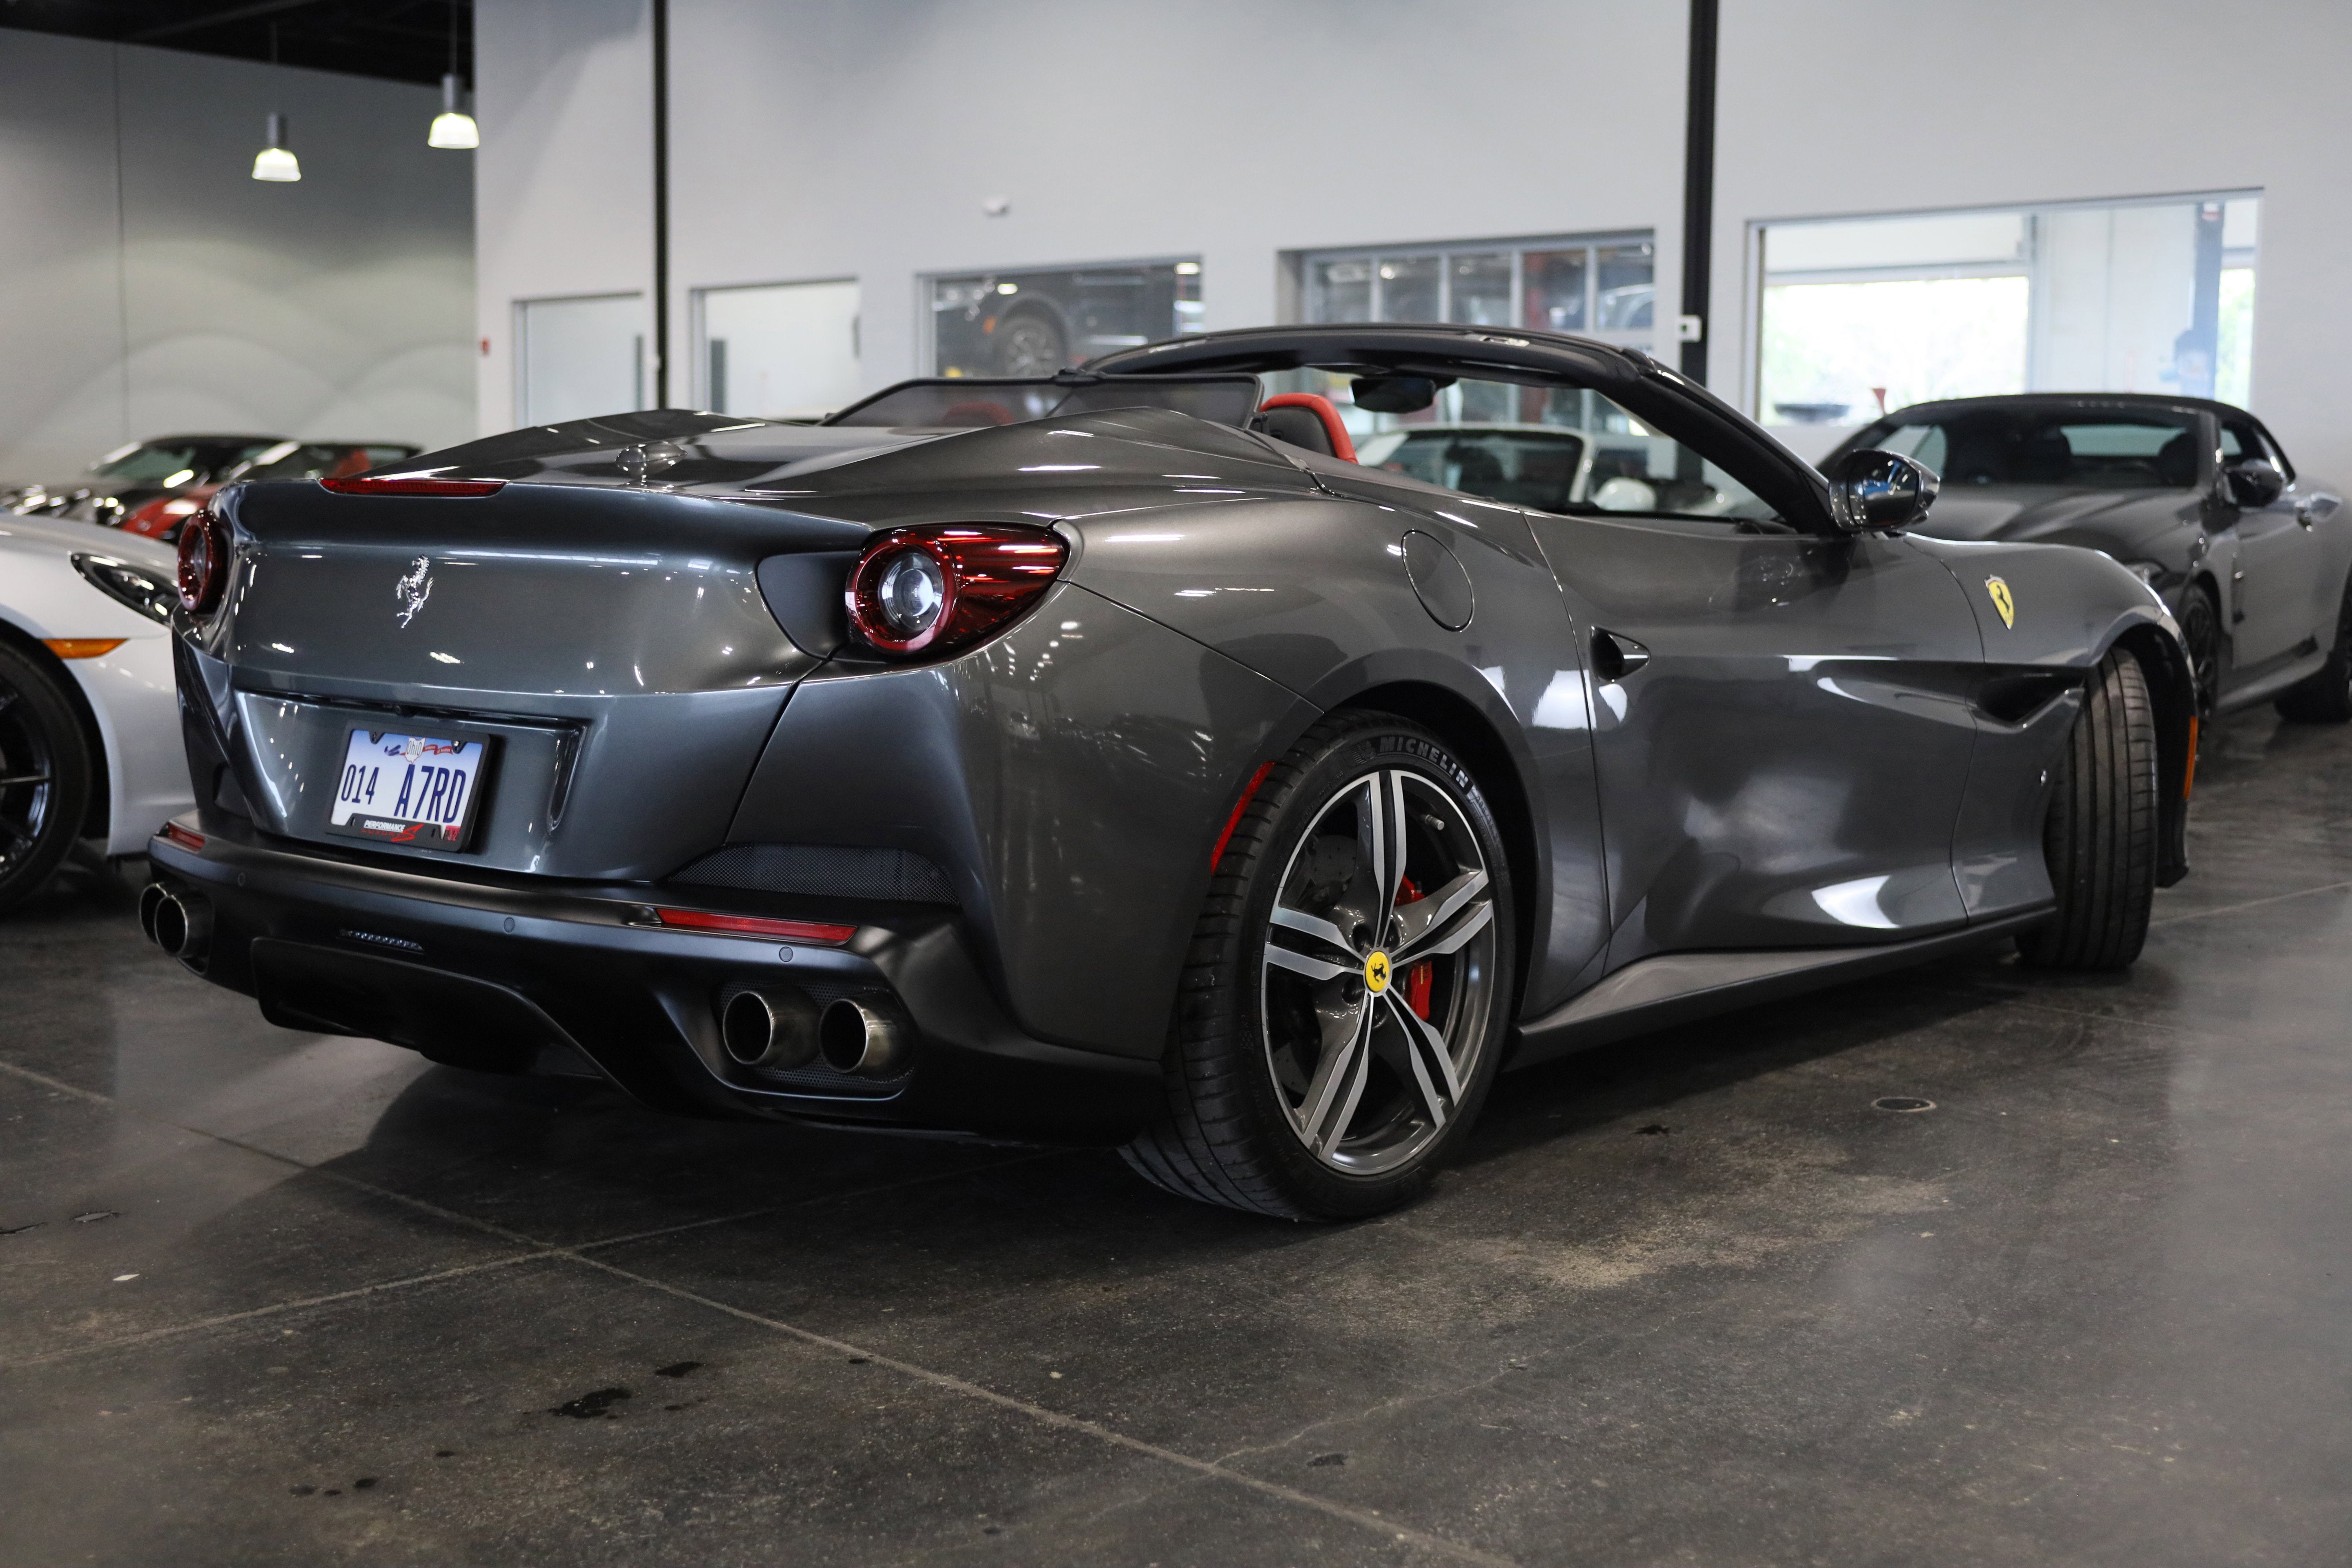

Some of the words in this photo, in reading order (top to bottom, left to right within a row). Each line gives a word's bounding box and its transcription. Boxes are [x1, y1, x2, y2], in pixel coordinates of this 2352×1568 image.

[1380, 737, 1468, 788] MICHELIN
[341, 764, 380, 805] 014
[394, 764, 466, 823] A7RD
[364, 820, 405, 831] PERFORMANCE
